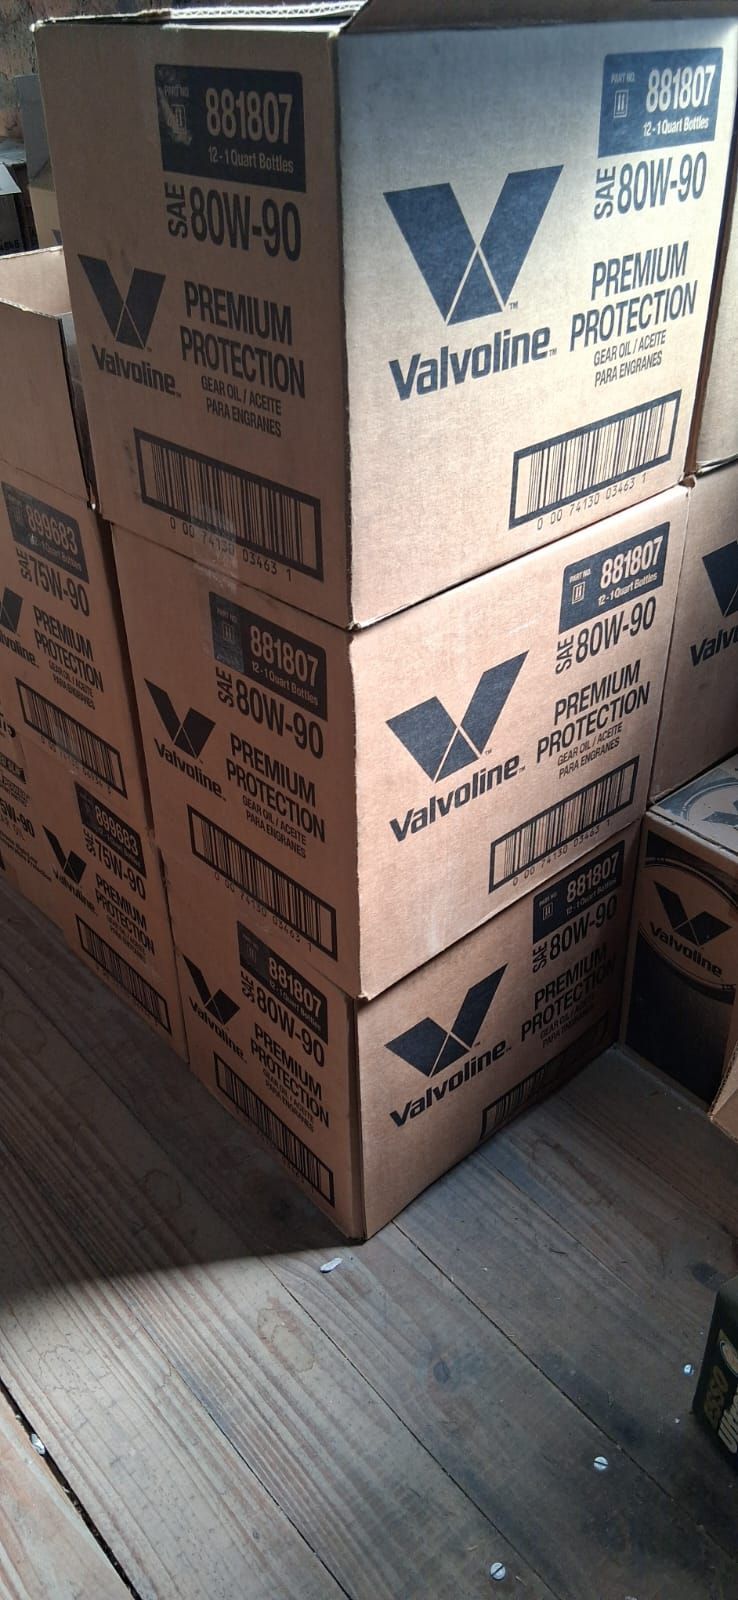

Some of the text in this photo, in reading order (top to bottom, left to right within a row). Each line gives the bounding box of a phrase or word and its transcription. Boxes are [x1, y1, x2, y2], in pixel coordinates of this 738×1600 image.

[205, 87, 293, 145] 881807
[645, 64, 716, 113] 881807
[661, 118, 682, 135] Quart
[683, 116, 709, 132] Bottles
[231, 149, 256, 169] Quart
[259, 152, 295, 174] Bottles
[593, 151, 707, 220] SAE 80W-90
[164, 182, 300, 262] SAE 80W-90
[591, 240, 690, 301] PREMIUM
[183, 279, 293, 346] PREMIUM
[569, 280, 698, 352] PROTECTION
[91, 344, 176, 395] Valvoline
[179, 325, 306, 399] PROTECTION
[388, 326, 552, 401] Valvoline
[593, 343, 617, 366] GEAR
[618, 340, 632, 359] OIL
[638, 330, 666, 352] ACEITE
[594, 350, 663, 389] PARA ENGRANES
[201, 375, 225, 398] GEAR
[227, 382, 241, 402] OIL
[249, 391, 282, 416] ACEITE
[206, 397, 282, 438] PARA ENGRANES
[26, 504, 79, 556] 899683
[537, 516, 544, 531] 0
[550, 508, 563, 525] 00
[569, 491, 600, 517] 74130
[605, 480, 636, 501] 03463
[169, 516, 177, 530] 0
[183, 521, 195, 539] 00
[242, 548, 278, 575] 03463
[286, 568, 293, 582] 1
[569, 571, 585, 583] PART
[599, 535, 663, 590] 881807
[16, 548, 32, 582] SAE
[29, 556, 90, 617] 75W-90
[633, 572, 658, 592] Bottles
[32, 604, 94, 662] PREMIUM
[33, 628, 105, 693] PROTECTION
[250, 625, 319, 687] 881807
[555, 595, 657, 675] SAE 80W-90
[690, 625, 738, 667] Valv
[215, 666, 324, 760] SAE 80W-90
[536, 681, 651, 764] PROTECTION
[554, 659, 641, 726] PREMIUM
[153, 737, 222, 798] Valvoline
[230, 732, 317, 807] PREMIUM
[557, 748, 580, 767] GEAR
[580, 740, 592, 758] OIL
[597, 722, 623, 746] ACEITE
[558, 736, 620, 779] PARA ENGRANES
[225, 758, 326, 843] PROTECTION
[242, 794, 262, 815] GEAR
[280, 818, 307, 846] ACEITE
[389, 754, 520, 844] Valvoline
[94, 805, 139, 857] 899683
[245, 809, 306, 858] PARA ENGRANES
[94, 838, 146, 901] 75W-90
[566, 851, 620, 903] 881807
[95, 888, 155, 956] PROTECTION
[96, 872, 147, 931] PREMIUM
[532, 895, 617, 973] SAE 80W-90
[649, 920, 723, 978] Valvoline
[268, 956, 322, 1018] 881807
[520, 957, 616, 1042] PROTECTION
[534, 943, 607, 1011] PREMIUM
[189, 996, 245, 1058] Valvoline
[256, 986, 325, 1067] 80W-90
[250, 1038, 330, 1128] PROTECTION
[254, 1022, 322, 1101] PREMIUM
[388, 1039, 506, 1128] Valvoline
